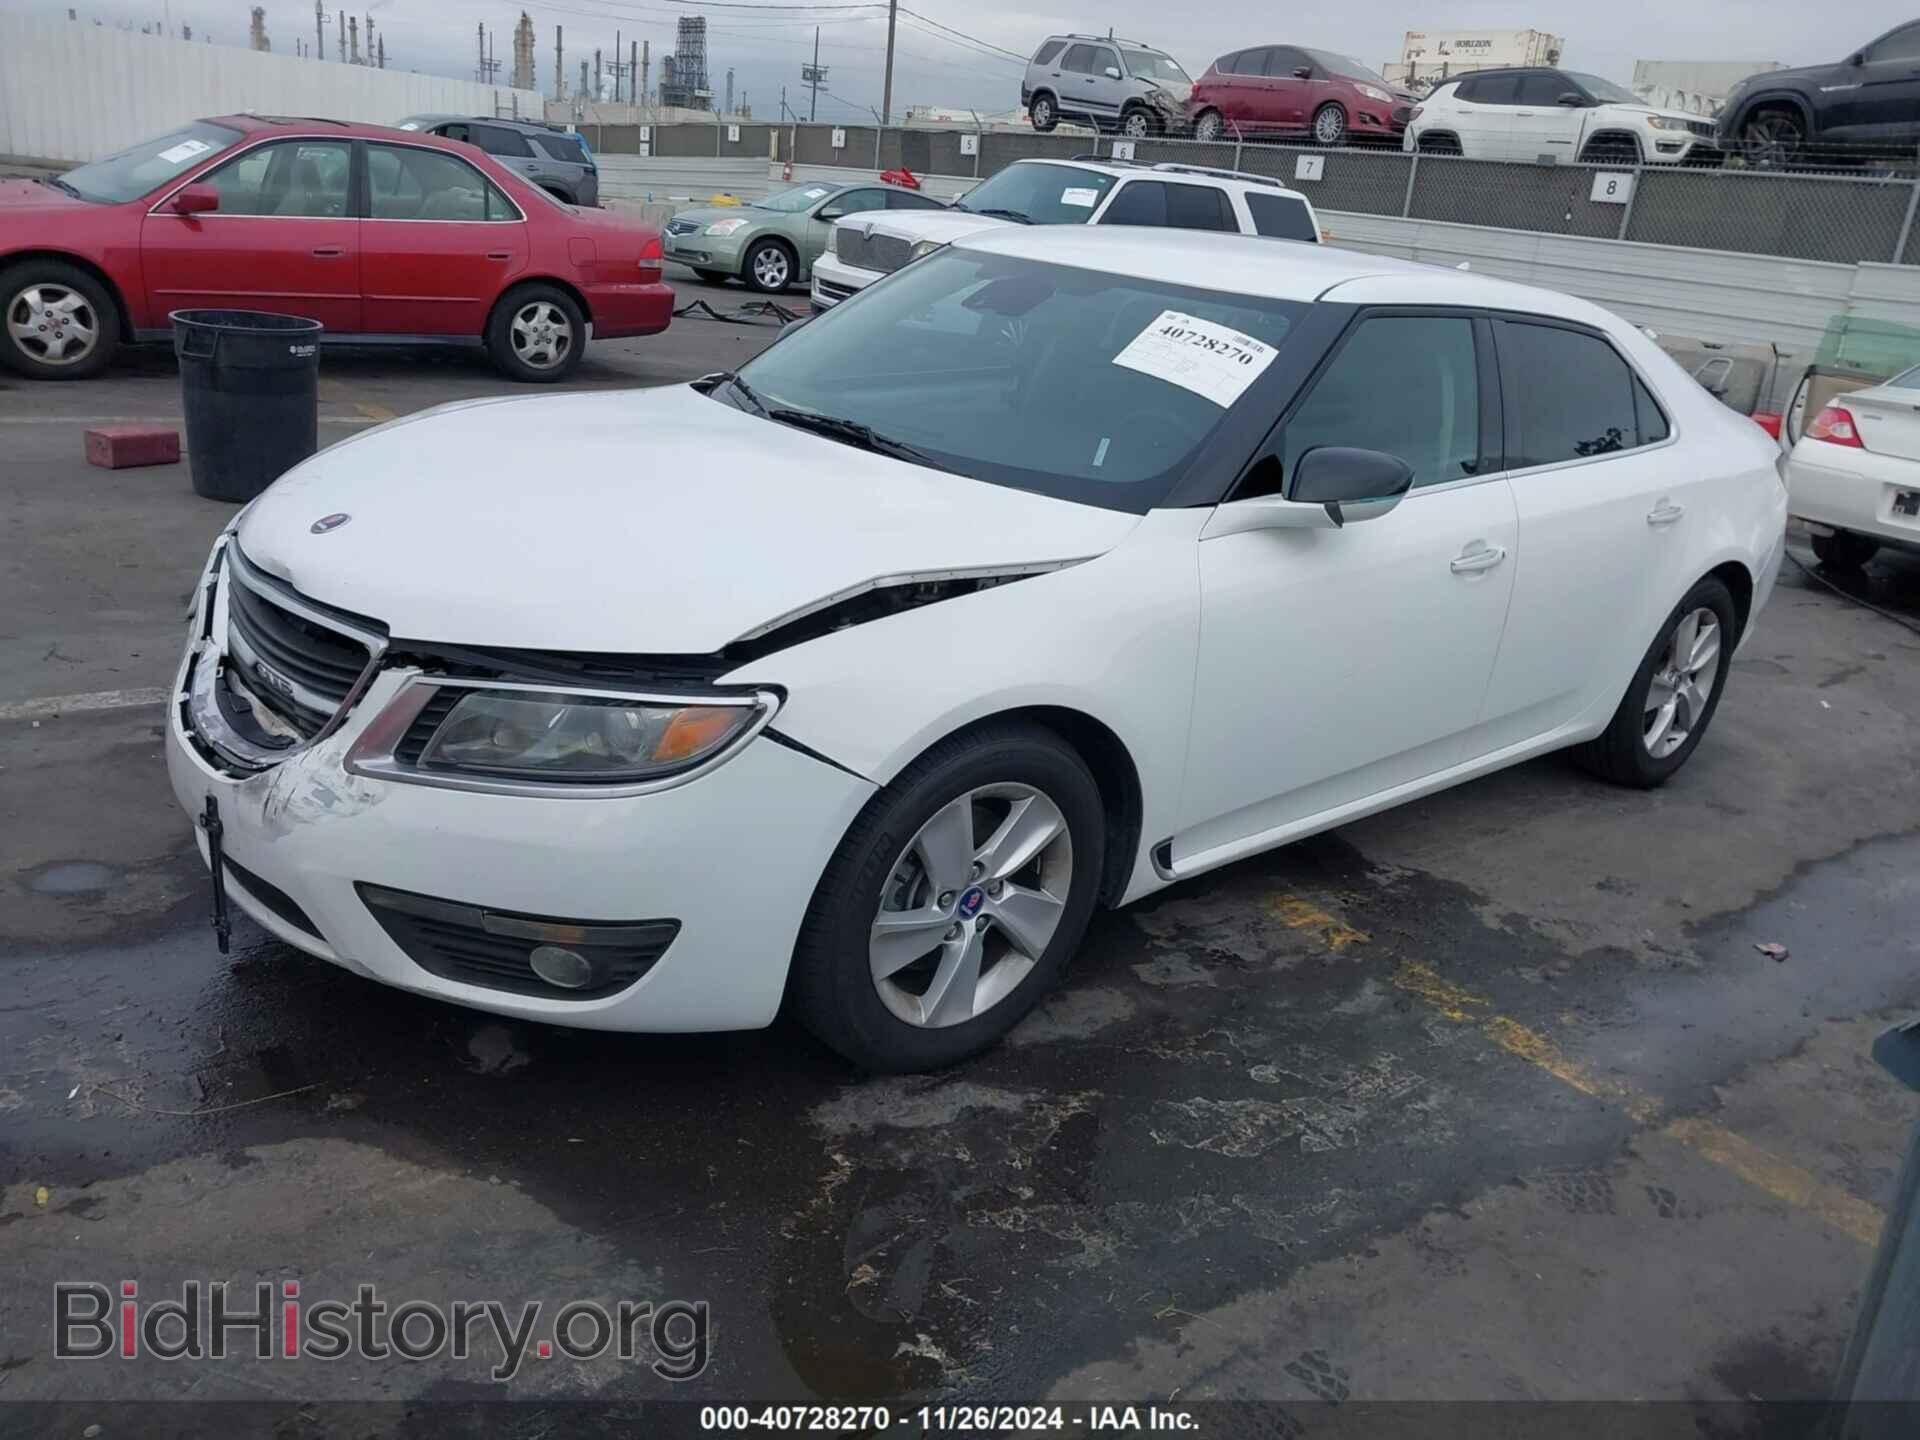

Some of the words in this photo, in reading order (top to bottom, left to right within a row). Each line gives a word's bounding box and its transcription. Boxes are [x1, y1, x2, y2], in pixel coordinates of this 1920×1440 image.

[1306, 161, 1314, 174] 7
[1606, 180, 1617, 195] 8
[1159, 325, 1254, 366] 40728270
